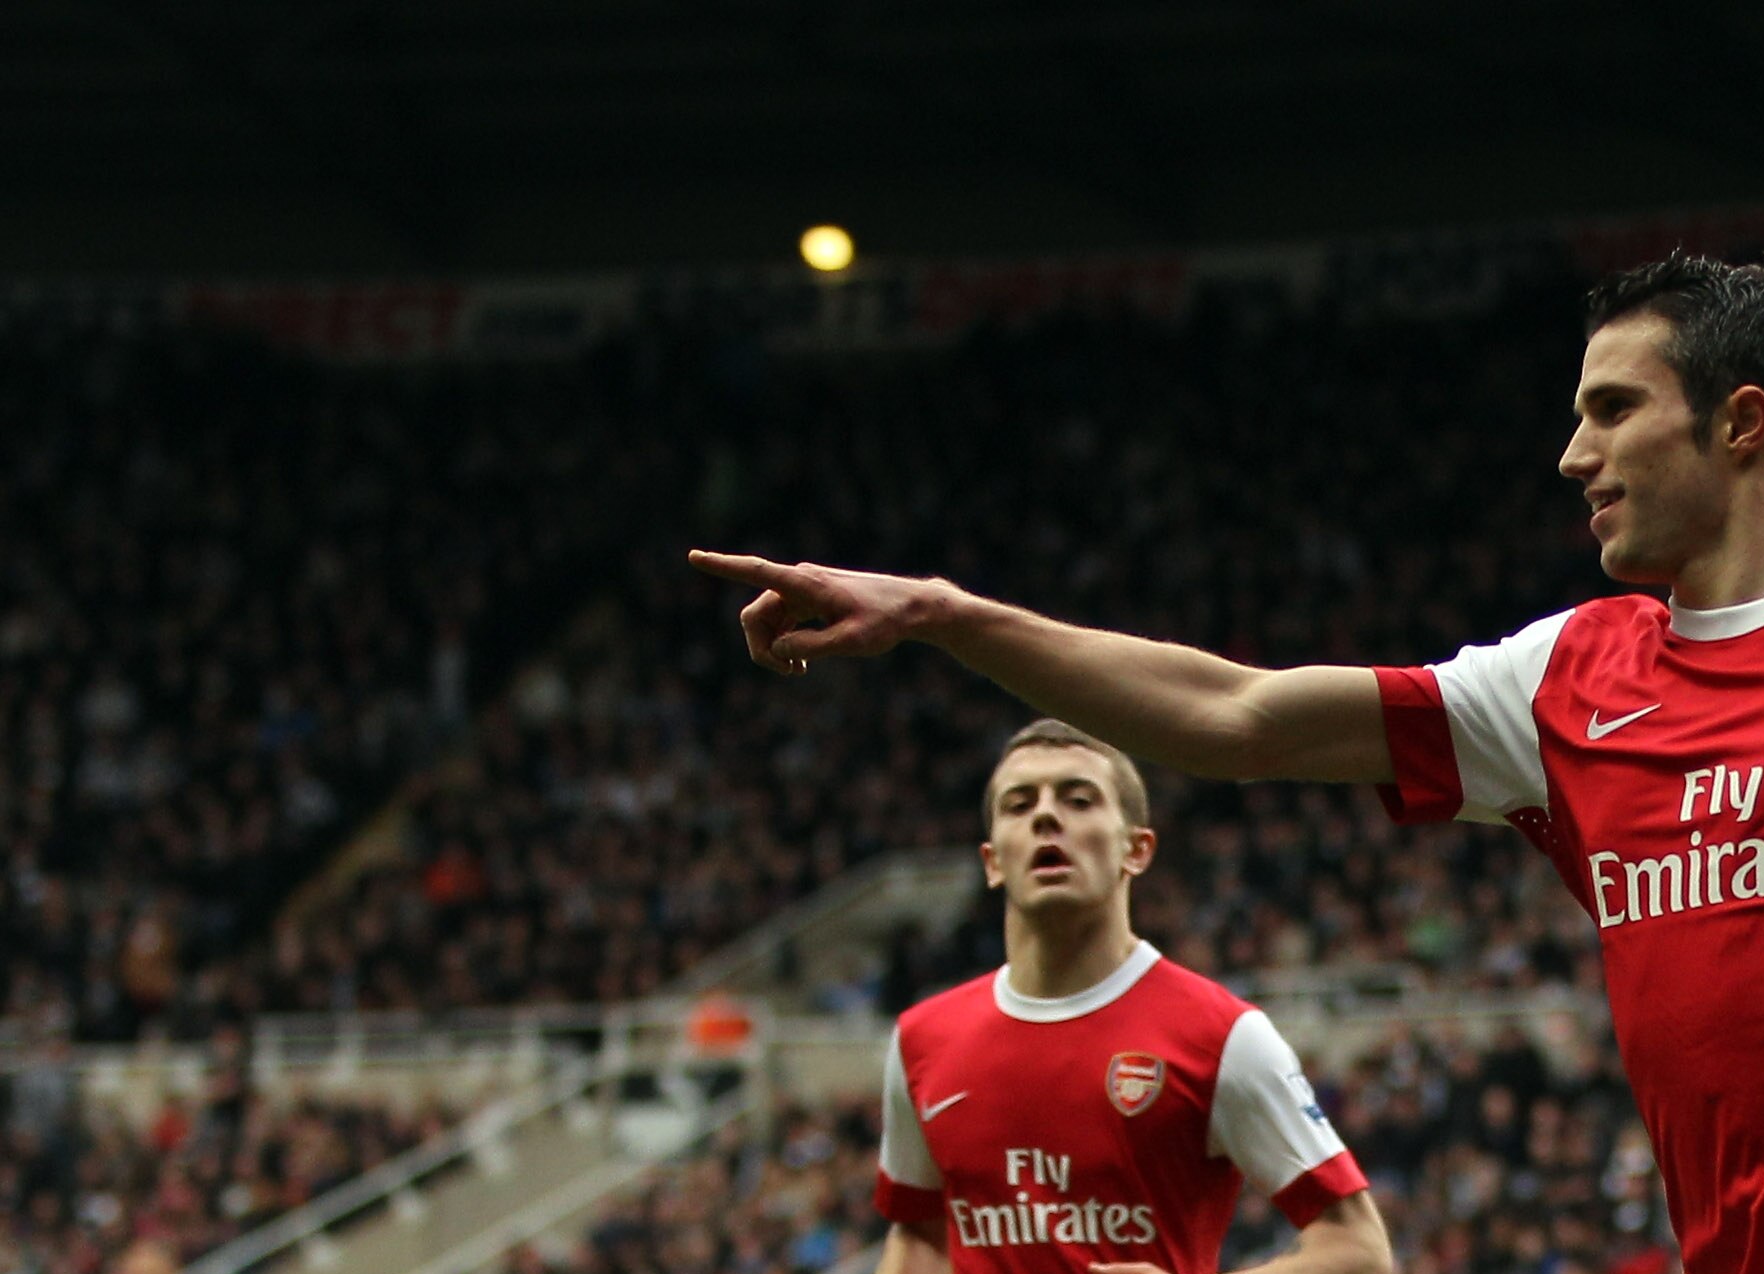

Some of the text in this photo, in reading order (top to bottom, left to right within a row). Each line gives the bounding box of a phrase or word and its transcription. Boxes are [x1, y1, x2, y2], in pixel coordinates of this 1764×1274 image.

[1680, 765, 1763, 822] Fly
[1005, 1148, 1070, 1191] Fly
[951, 1192, 1157, 1248] Emirates
